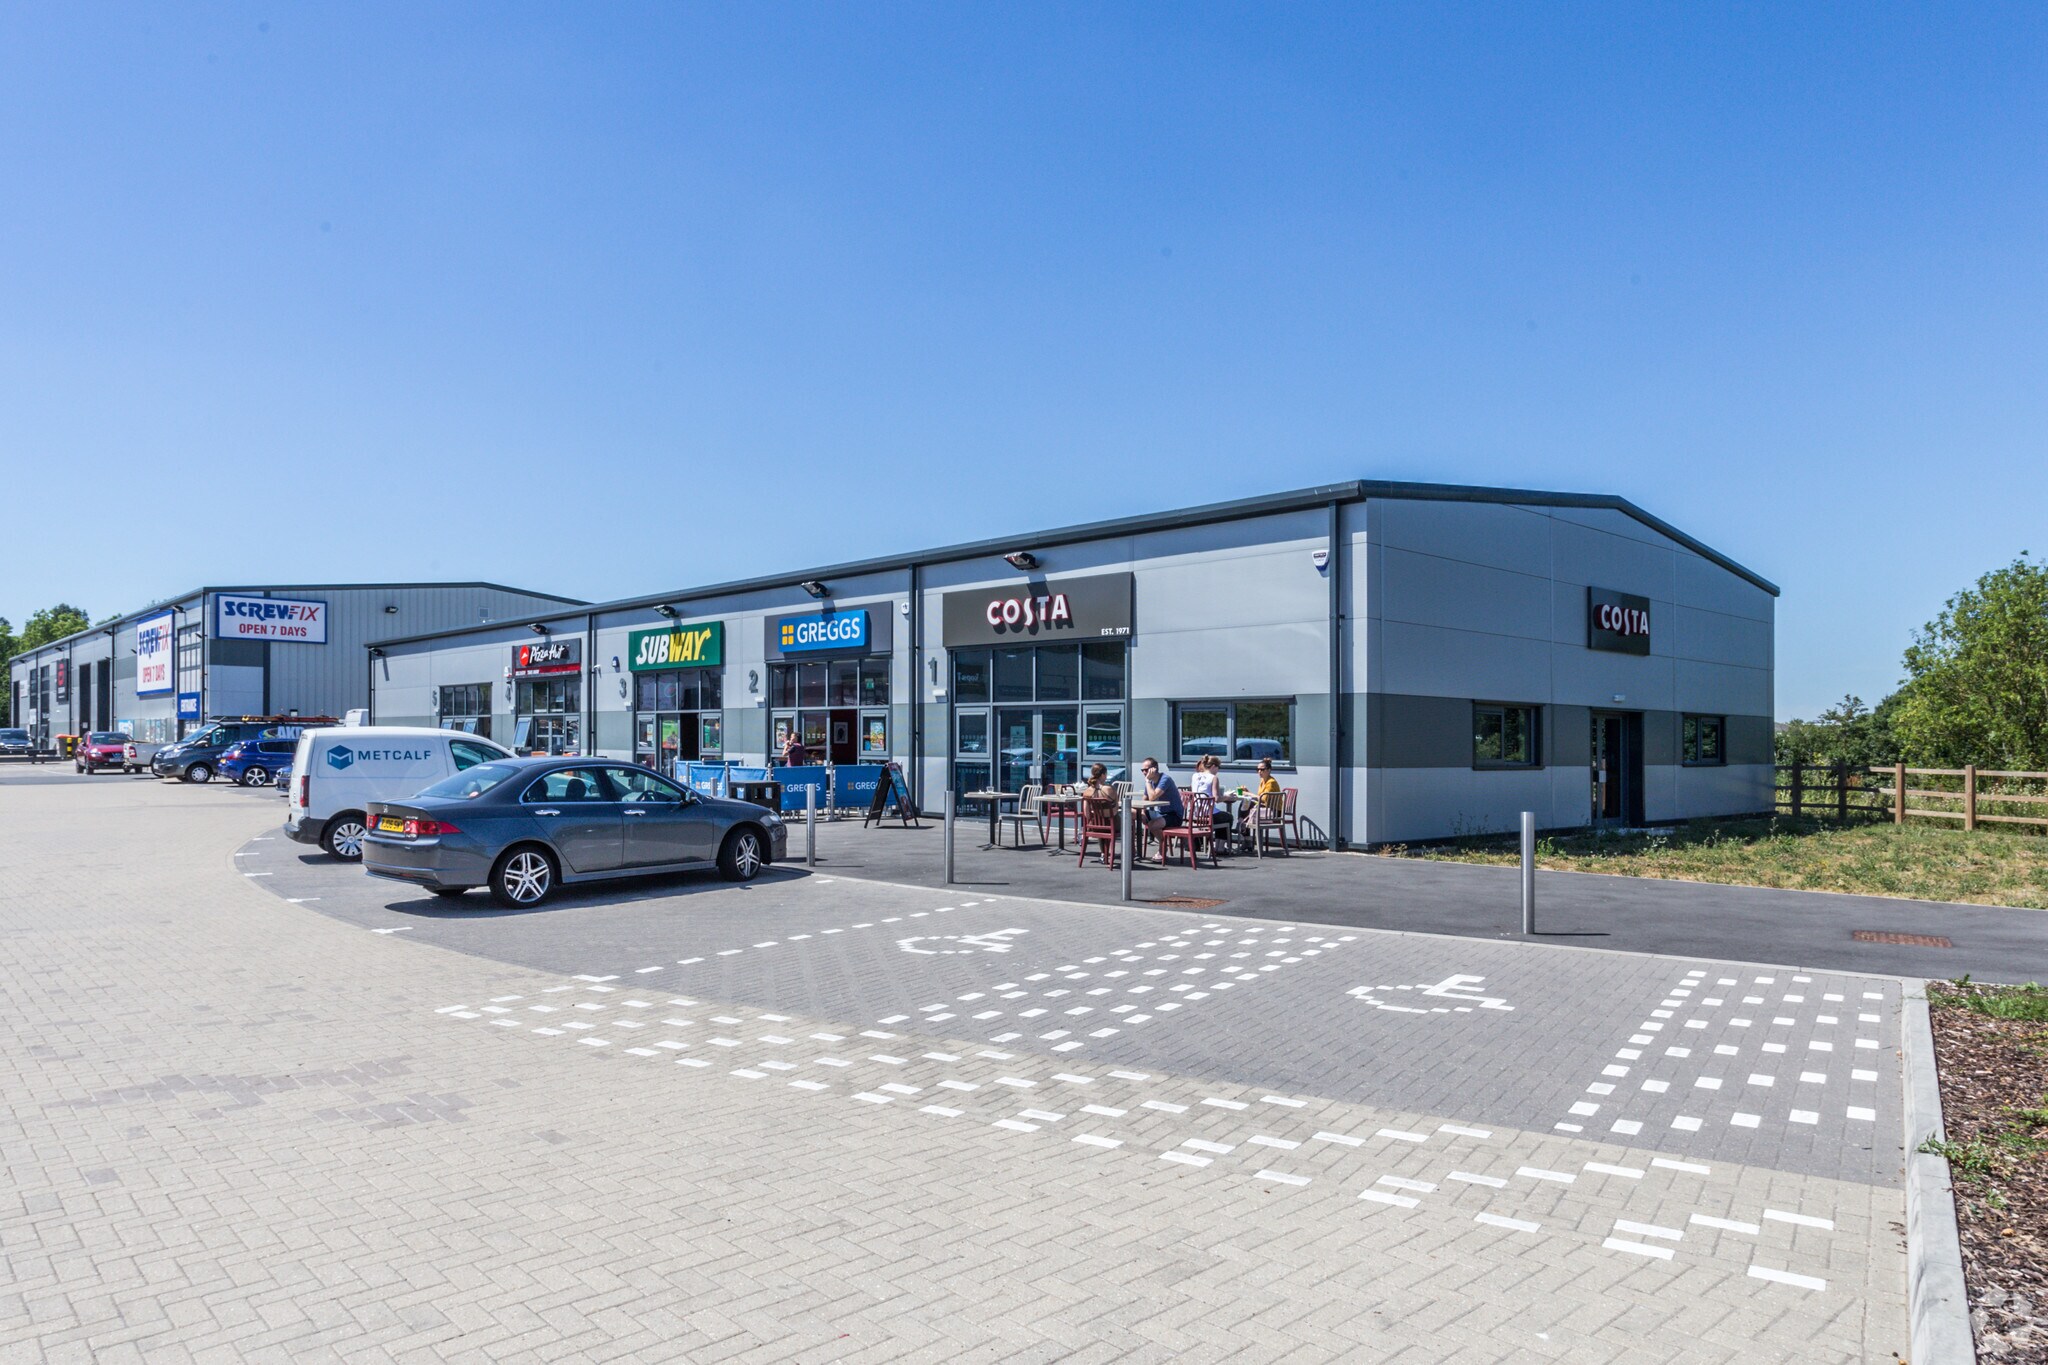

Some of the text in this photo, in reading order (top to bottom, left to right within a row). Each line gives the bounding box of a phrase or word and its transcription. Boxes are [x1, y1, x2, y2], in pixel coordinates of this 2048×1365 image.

[224, 601, 320, 621] SCREWFIX
[986, 594, 1070, 626] COSTA
[1601, 604, 1649, 636] COSTA
[239, 623, 307, 637] OPEN 7 DAYS
[797, 617, 860, 643] GREGGS
[1116, 627, 1130, 635] 1971
[138, 623, 170, 659] SCREWFIX
[635, 627, 712, 666] SUBWAY
[529, 644, 565, 664] Pizza Hut
[620, 678, 627, 698] 3
[749, 669, 758, 693] 2
[358, 750, 431, 761] METCALF
[787, 783, 821, 793] GREGS
